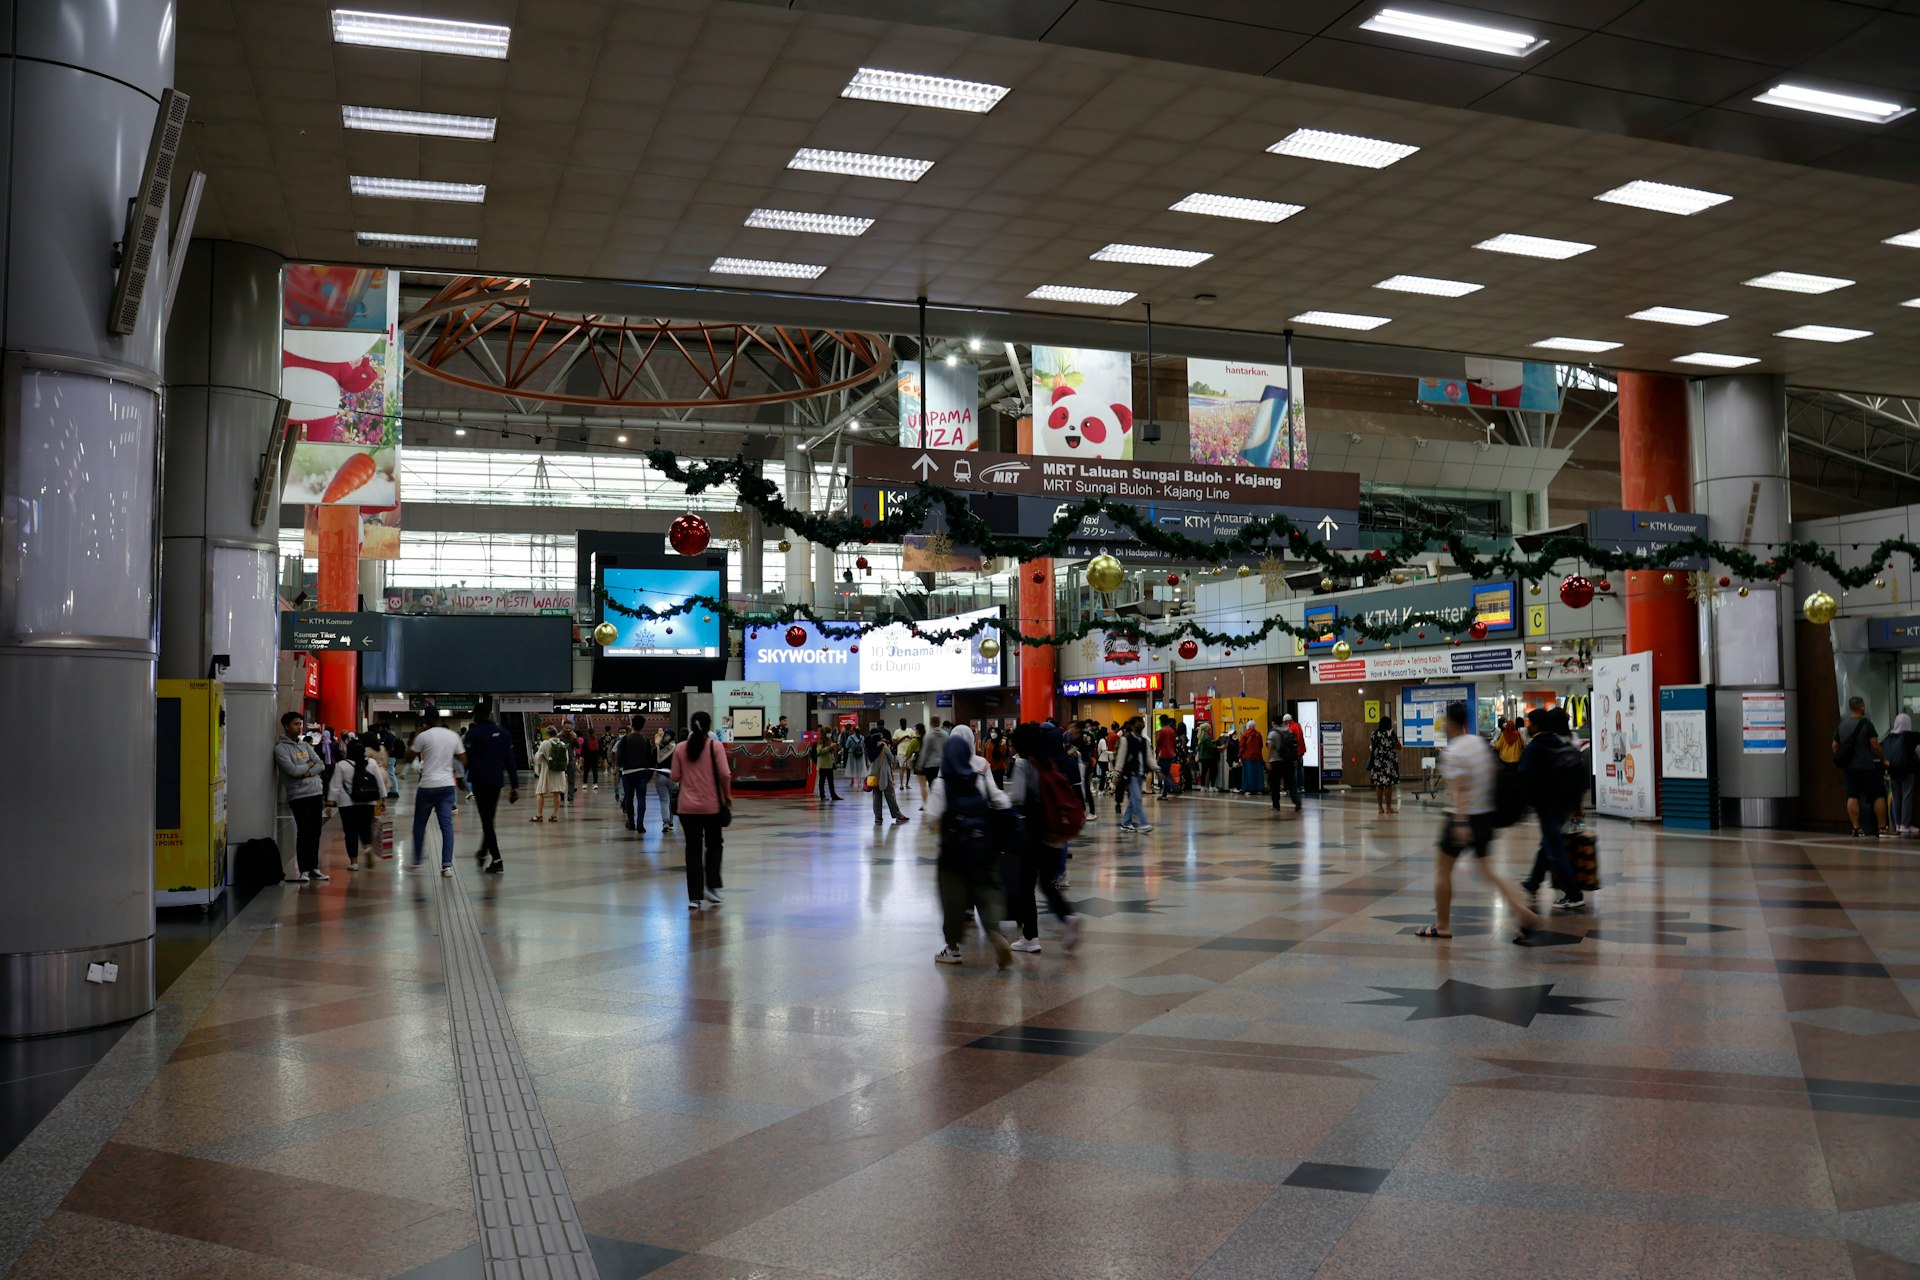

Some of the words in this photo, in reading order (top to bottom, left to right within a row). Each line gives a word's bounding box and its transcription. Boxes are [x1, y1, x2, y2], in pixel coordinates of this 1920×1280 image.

[1225, 364, 1269, 377] hantarkan.
[993, 471, 1020, 484] MRT
[1043, 462, 1075, 476] MRT
[1080, 465, 1128, 479] Laluan
[1132, 467, 1180, 484] Sungai
[1184, 469, 1223, 484] Buloh
[1235, 471, 1282, 490] Kajang
[1043, 478, 1072, 492] MRT
[1076, 479, 1116, 495] Sungai
[1120, 482, 1152, 496] Buloh
[1164, 484, 1203, 501] Kajang
[1206, 486, 1230, 499] Line
[1184, 515, 1210, 528] KTM
[1650, 521, 1667, 531] KTM
[1668, 522, 1697, 533] Komuter
[1082, 527, 1115, 537] タクシー
[1115, 548, 1124, 556] Di
[1125, 548, 1158, 558] Hadapan
[496, 595, 529, 608] MESTI
[533, 597, 574, 608] WANGI
[1365, 608, 1398, 627] KTM
[1533, 612, 1542, 628] C
[1907, 626, 1920, 637] KT
[757, 648, 848, 664] SKYWORTH
[871, 646, 884, 657] 10
[888, 645, 934, 657] Jenama
[870, 661, 882, 671] di
[886, 661, 920, 671] Dunia
[1374, 659, 1392, 667] Selamat
[1393, 658, 1406, 666] Jalan
[1412, 656, 1428, 664] Terima
[1429, 655, 1442, 663] Kasih
[1387, 669, 1407, 677] Pleasant
[1408, 668, 1417, 676] Trip
[1422, 667, 1437, 675] Thank
[1079, 681, 1088, 693] 24
[1107, 677, 1146, 691] McDonald's
[1670, 690, 1674, 699] 1
[1368, 706, 1376, 719] C
